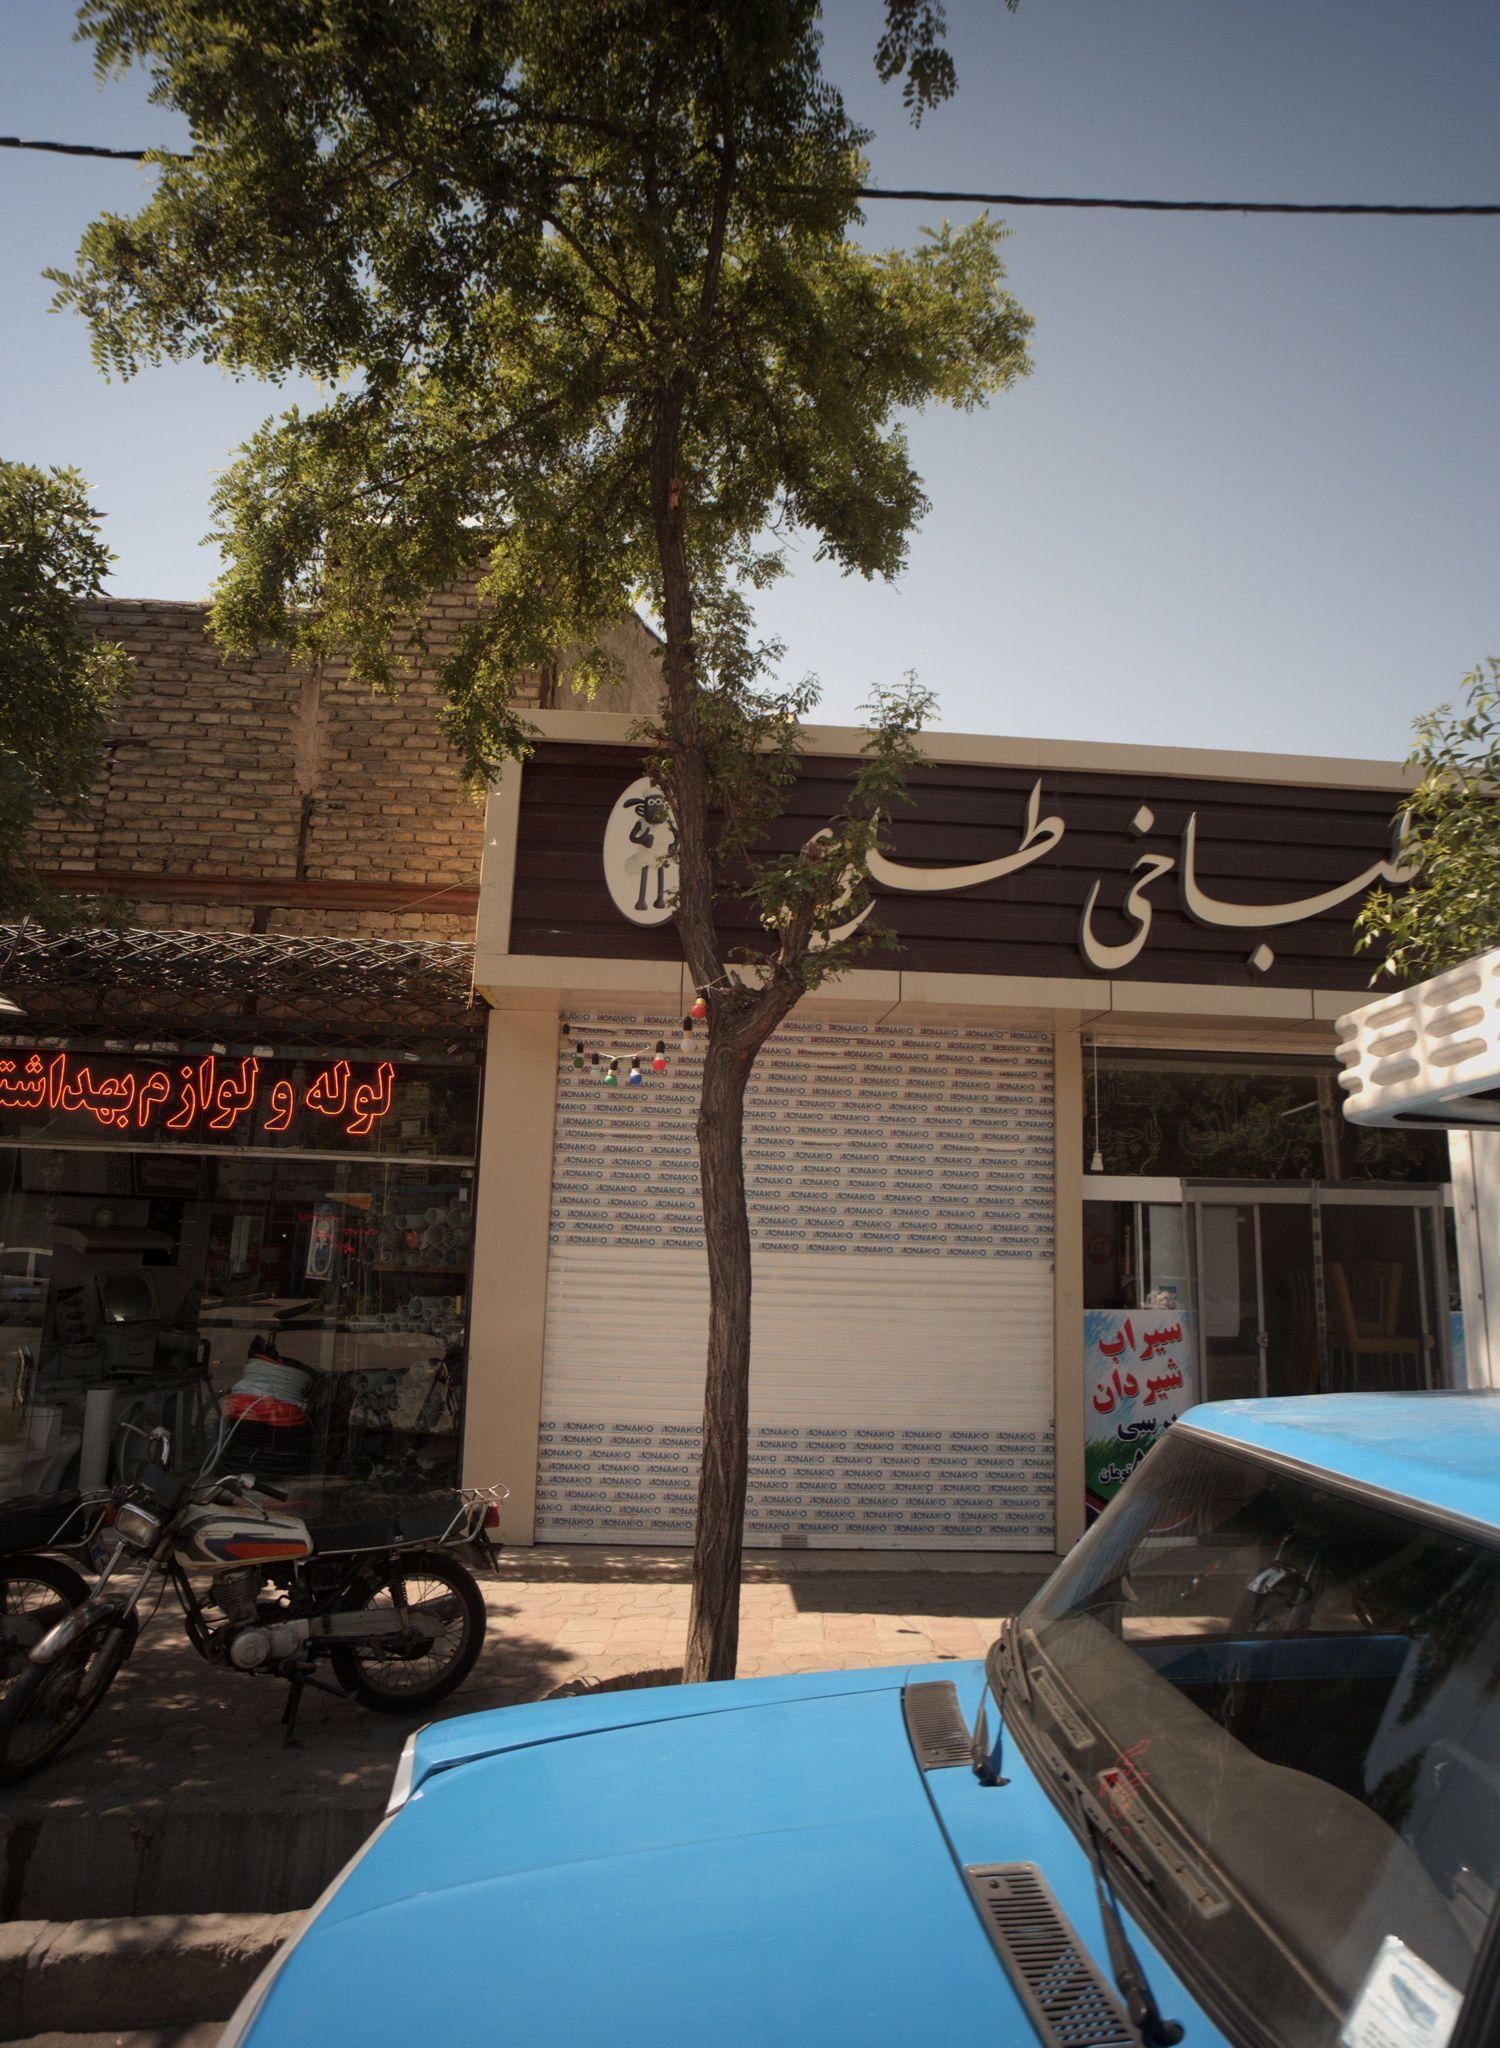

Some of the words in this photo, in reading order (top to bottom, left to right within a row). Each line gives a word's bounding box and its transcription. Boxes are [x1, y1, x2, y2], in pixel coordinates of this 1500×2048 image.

[0, 1053, 135, 1128] بهداشت
[139, 1055, 259, 1129] لوازم
[264, 1080, 294, 1131] و
[306, 1060, 395, 1134] لوله
[1098, 1317, 1182, 1364] سیراب
[1093, 1358, 1184, 1414] شیردان
[1099, 1463, 1131, 1484] تومان
